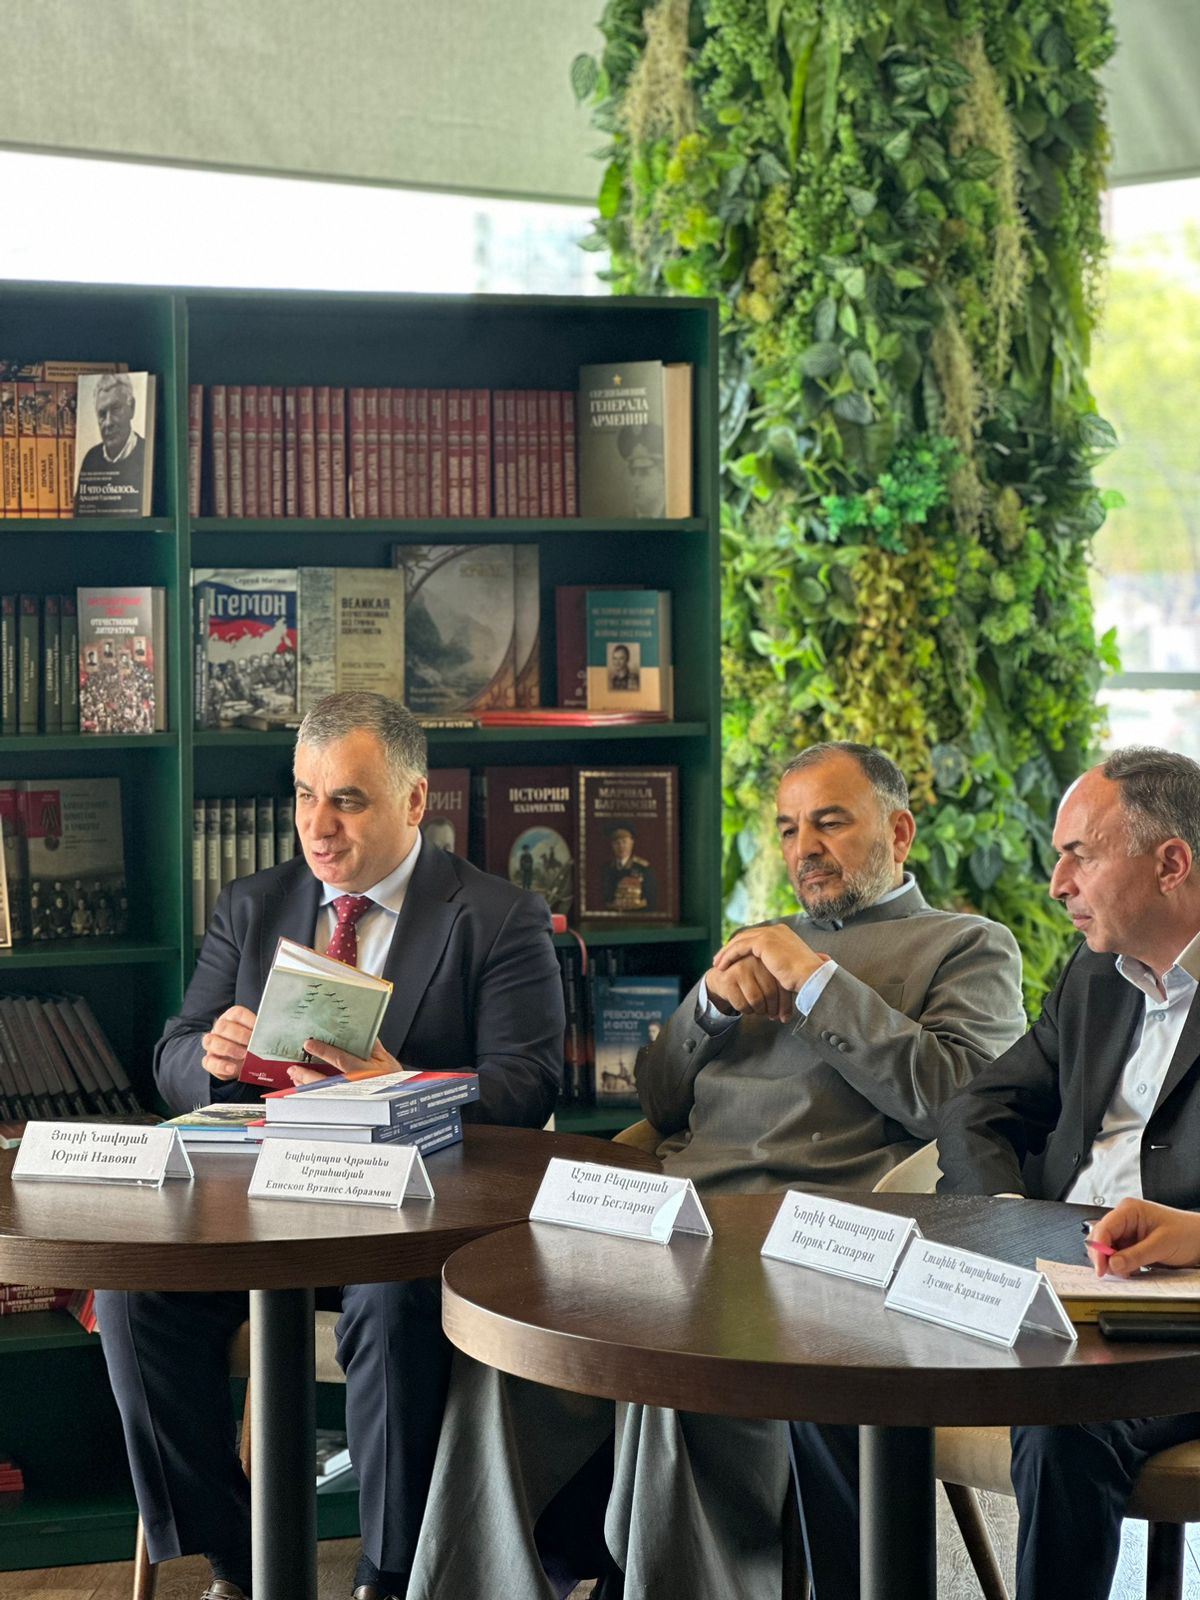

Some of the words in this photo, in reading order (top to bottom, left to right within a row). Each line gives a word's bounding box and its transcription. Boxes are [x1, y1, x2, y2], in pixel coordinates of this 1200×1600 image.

[591, 413, 649, 427] АРМЕНИИ
[341, 597, 391, 609] ВЕЛИКАЯ
[426, 790, 463, 811] РИН
[509, 787, 570, 802] ИСТОРИЯ
[598, 788, 653, 799] МАРШАЛ
[513, 802, 566, 813] КАЗАЧЕСТВА
[603, 1010, 662, 1020] РЕВОЛЮЦИЯ
[603, 1020, 611, 1030] И
[612, 1020, 639, 1030] ФЛОТ
[51, 1129, 87, 1144] Յուրի
[90, 1131, 149, 1146] Նավոյան
[51, 1149, 89, 1164] Юрий
[90, 1152, 137, 1165] Навоян
[570, 1167, 601, 1183] Աշոտ
[265, 1179, 305, 1191] Епископ
[306, 1182, 344, 1194] Вртанес
[344, 1186, 392, 1198] Абраамян
[566, 1191, 600, 1204] Ашот
[601, 1194, 656, 1215] Бегларян
[793, 1205, 826, 1227] Նորիկ
[791, 1230, 825, 1251] Норик
[825, 1238, 876, 1263] Гаспарян
[17, 1289, 55, 1299] СТАЛИНА
[922, 1273, 954, 1292] Лусине
[954, 1282, 1002, 1306] Караханян
[11, 1303, 50, 1313] СТАЛИНА
